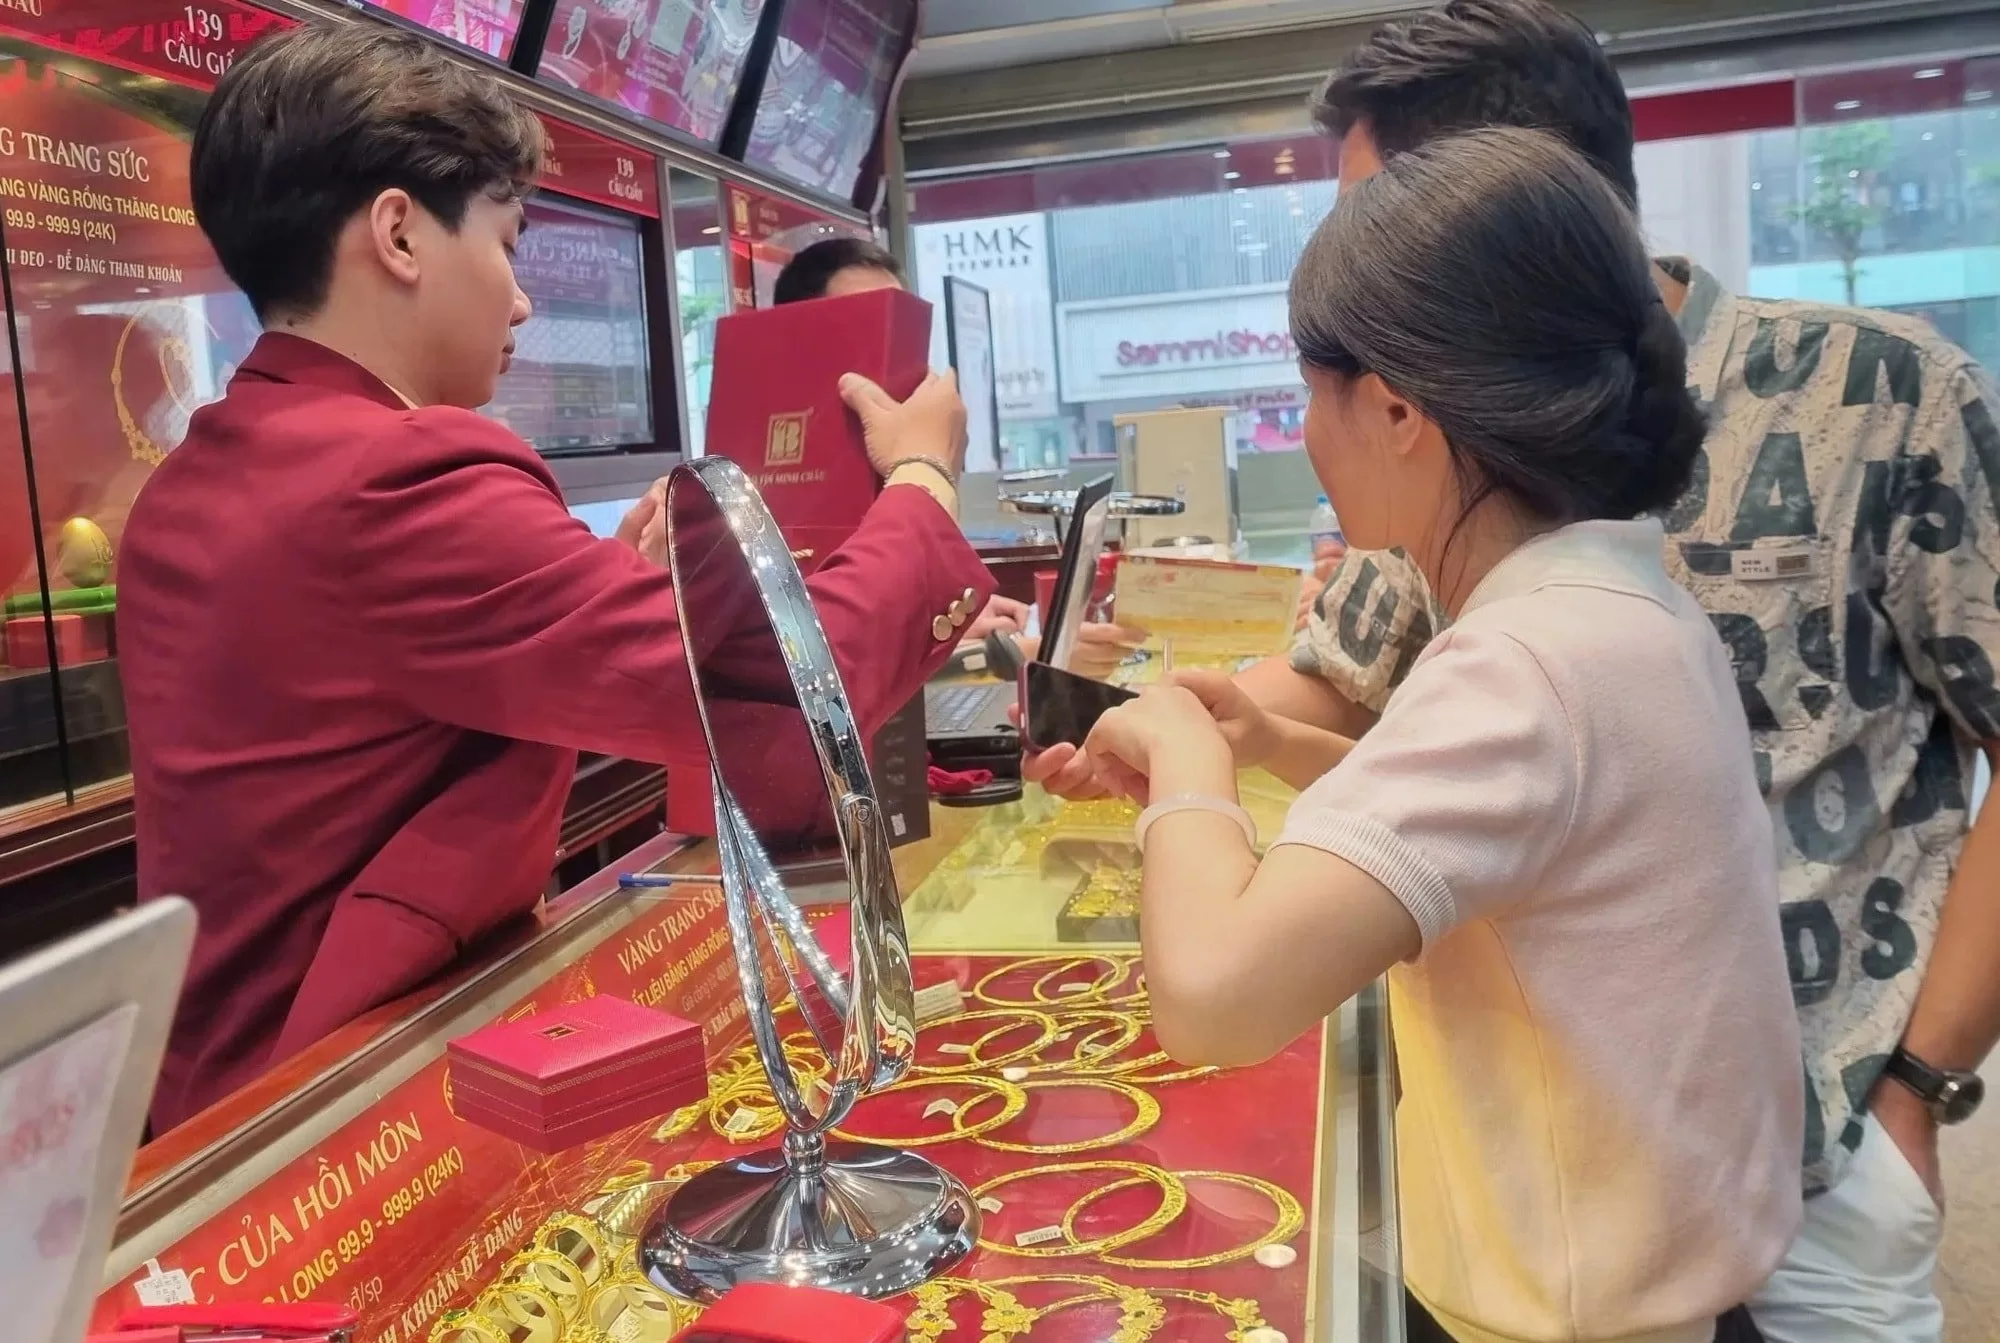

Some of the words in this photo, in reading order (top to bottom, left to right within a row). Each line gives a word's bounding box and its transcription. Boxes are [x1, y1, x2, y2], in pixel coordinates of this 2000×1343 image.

[184, 5, 222, 41] 139
[165, 31, 201, 69] CẦU
[206, 48, 235, 77] GIẤ
[21, 131, 101, 173] TRANG
[107, 147, 149, 183] SỨC
[6, 208, 35, 230] 99.9
[45, 214, 81, 236] 999.9
[83, 219, 117, 245] (24K)
[28, 179, 69, 206] VÀNG
[72, 184, 112, 213] RỒNG
[115, 196, 158, 221] THĂNG
[161, 205, 196, 227] LONG
[943, 224, 1032, 258] HMK
[20, 249, 45, 267] ĐEO
[57, 249, 72, 271] DỄ
[75, 255, 106, 274] DÀNG
[109, 260, 145, 279] THANH
[147, 264, 183, 283] KHOẢN
[617, 928, 664, 976] VÀNG
[658, 891, 707, 945] TRANG
[218, 1214, 294, 1286] CỦA
[293, 1156, 353, 1231] HỒI
[355, 1111, 423, 1185] MÔN
[337, 1218, 375, 1264] 99.9
[382, 1177, 425, 1226] 999.9
[423, 1145, 464, 1197] (24K)
[401, 1272, 460, 1339] KHOẢN
[483, 1207, 524, 1260] DÀNG
